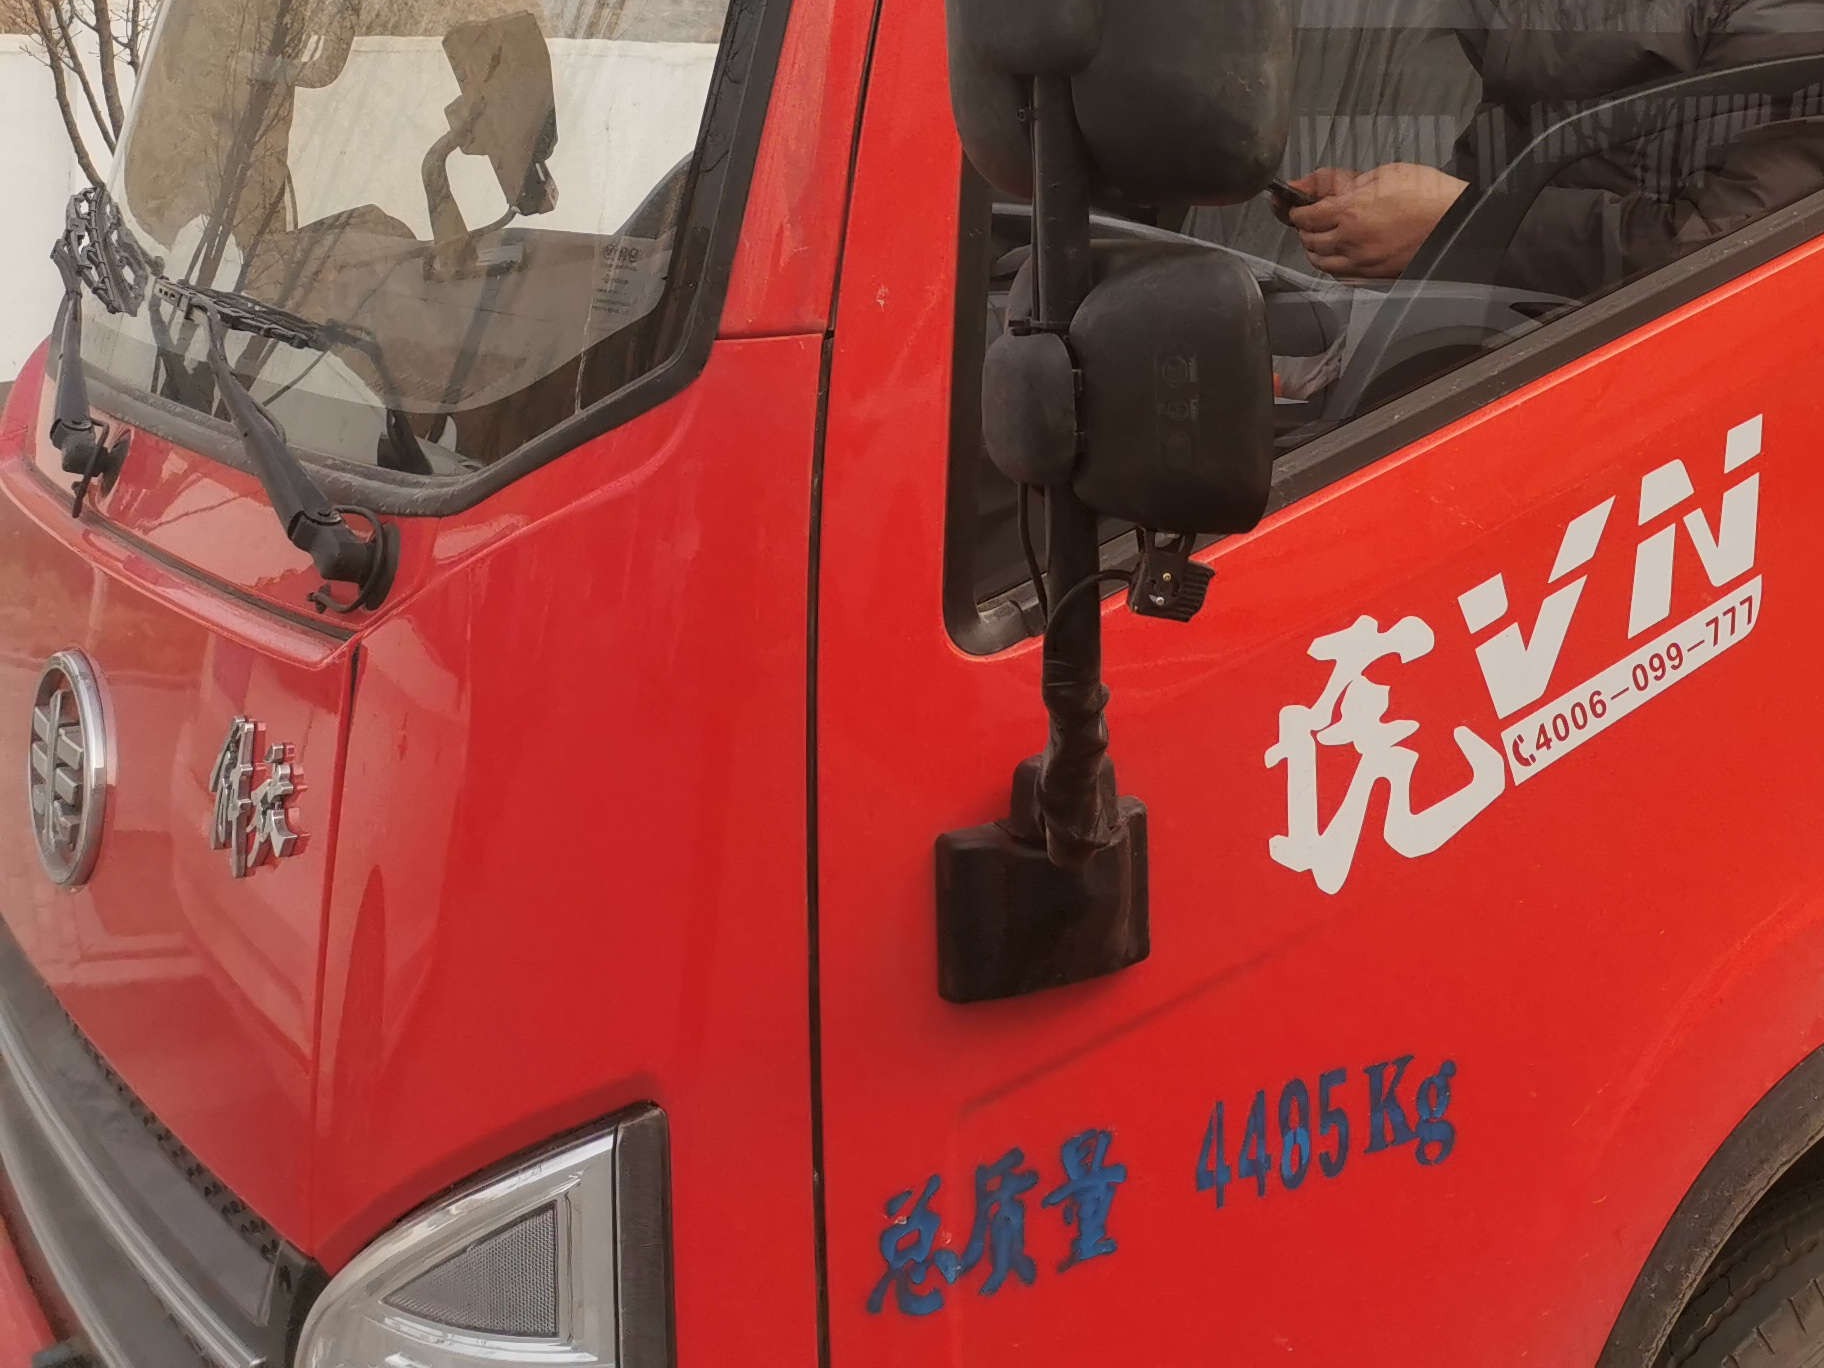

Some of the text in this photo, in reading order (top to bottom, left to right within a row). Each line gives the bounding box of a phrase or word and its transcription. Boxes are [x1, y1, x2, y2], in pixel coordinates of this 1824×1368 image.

[1534, 595, 1755, 754] 4006-099-777
[866, 1128, 1126, 1315] 总质量
